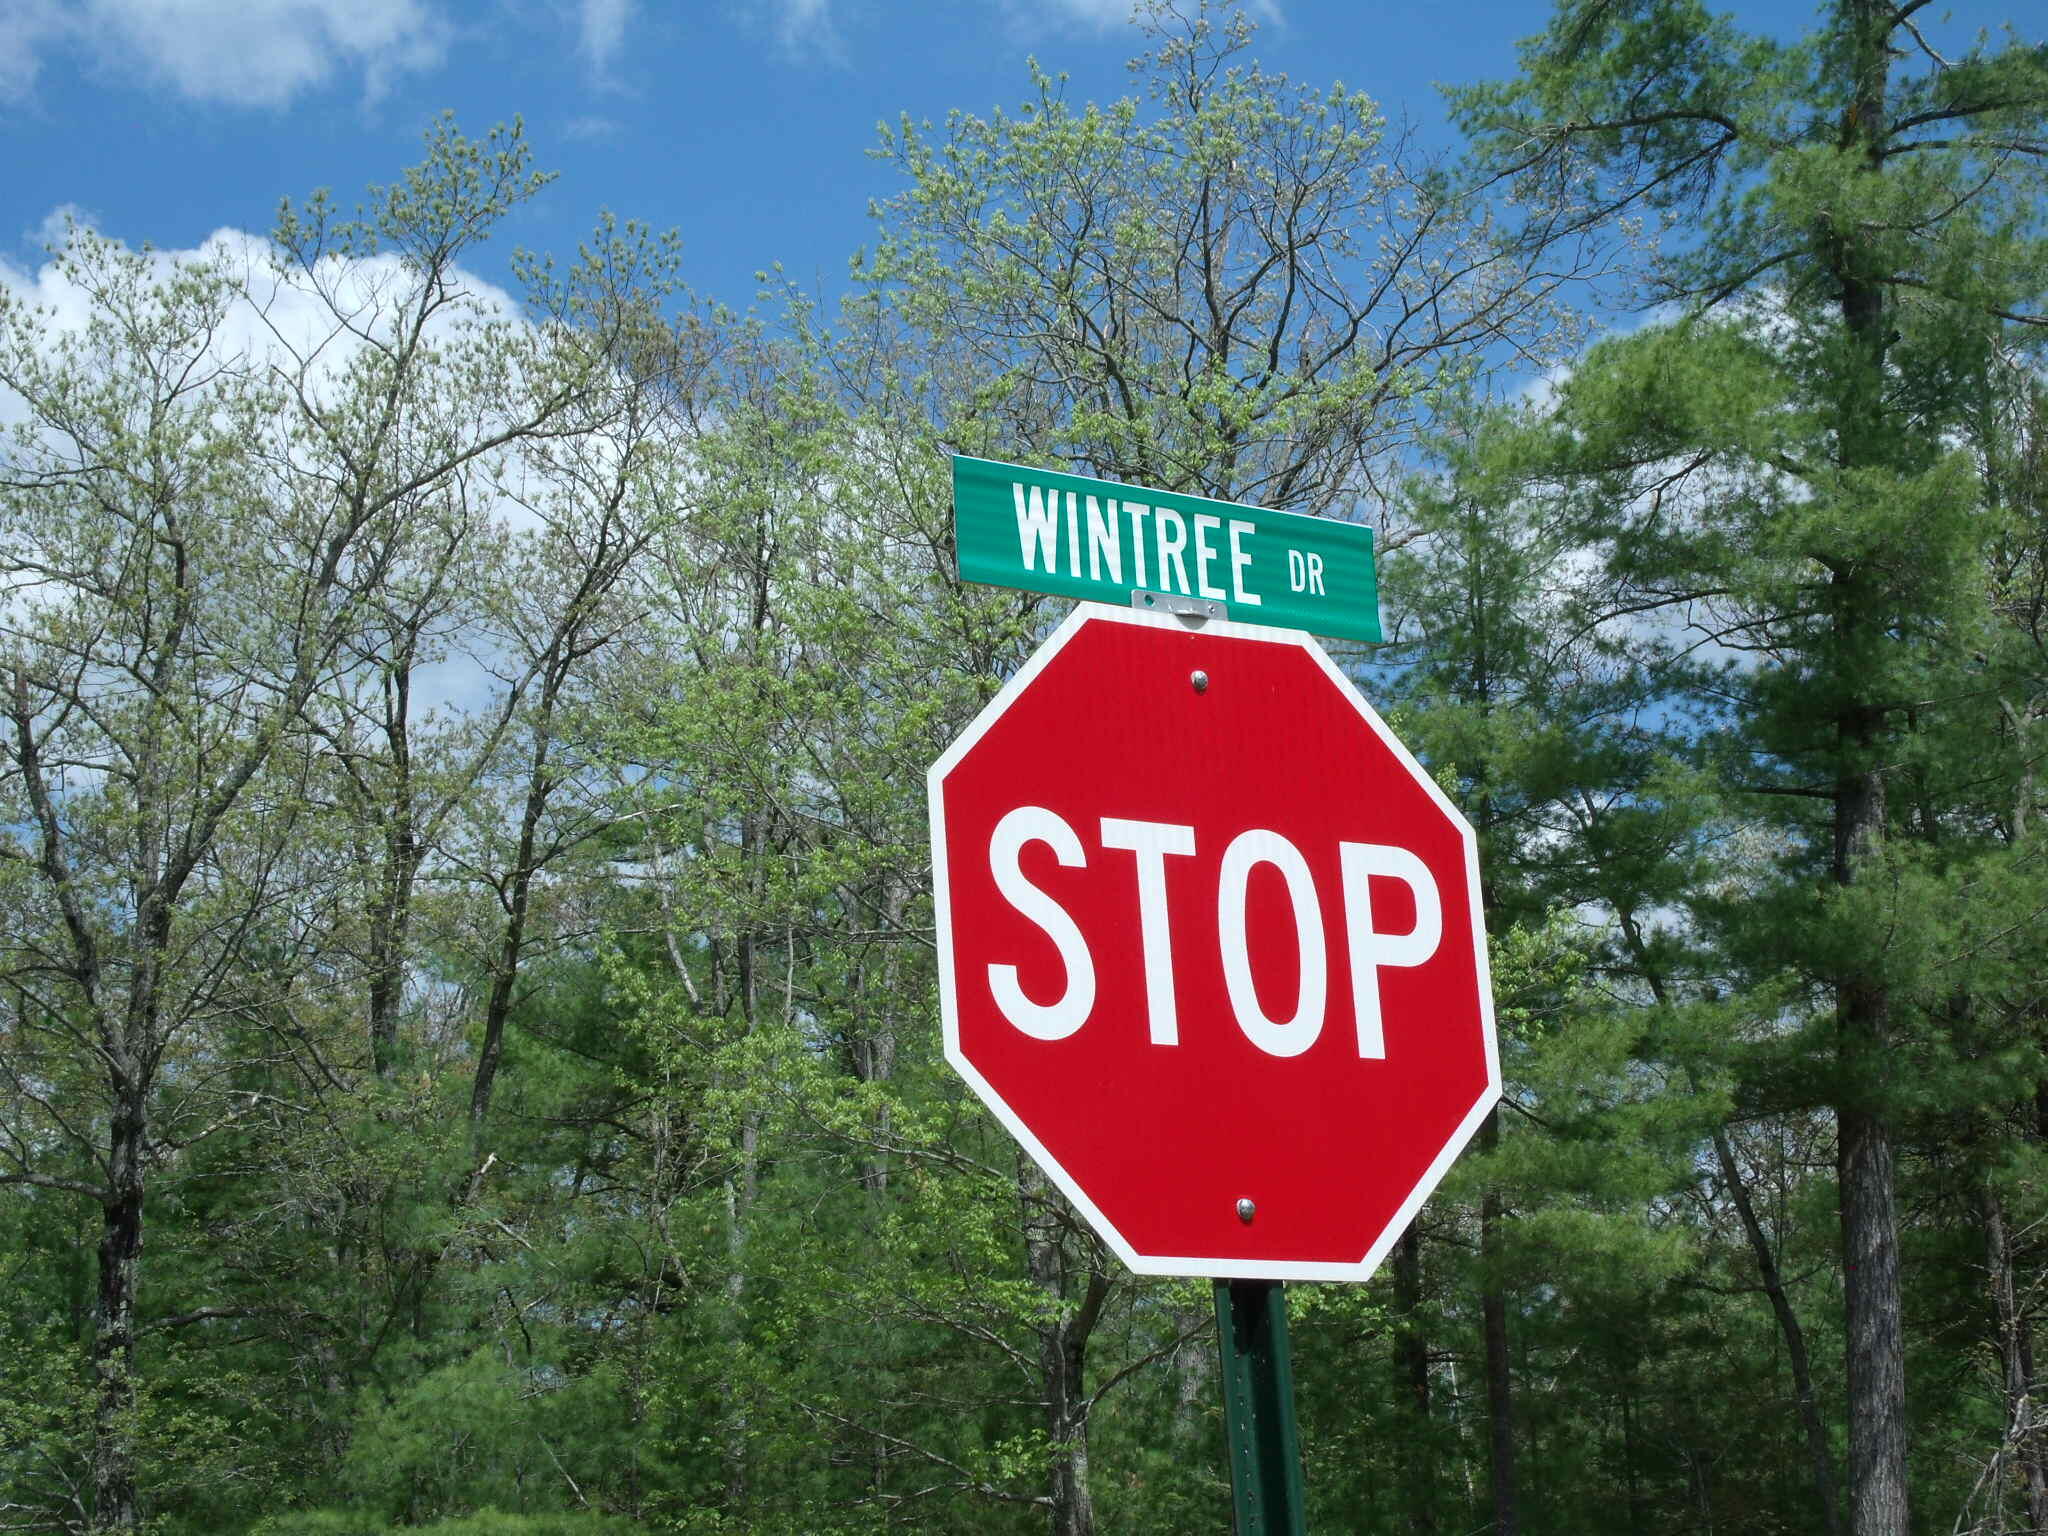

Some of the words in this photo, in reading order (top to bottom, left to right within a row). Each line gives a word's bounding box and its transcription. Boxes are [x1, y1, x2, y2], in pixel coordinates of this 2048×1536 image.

[1012, 482, 1262, 606] WINTREE
[1288, 549, 1326, 596] DR
[987, 806, 1443, 1060] STOP
